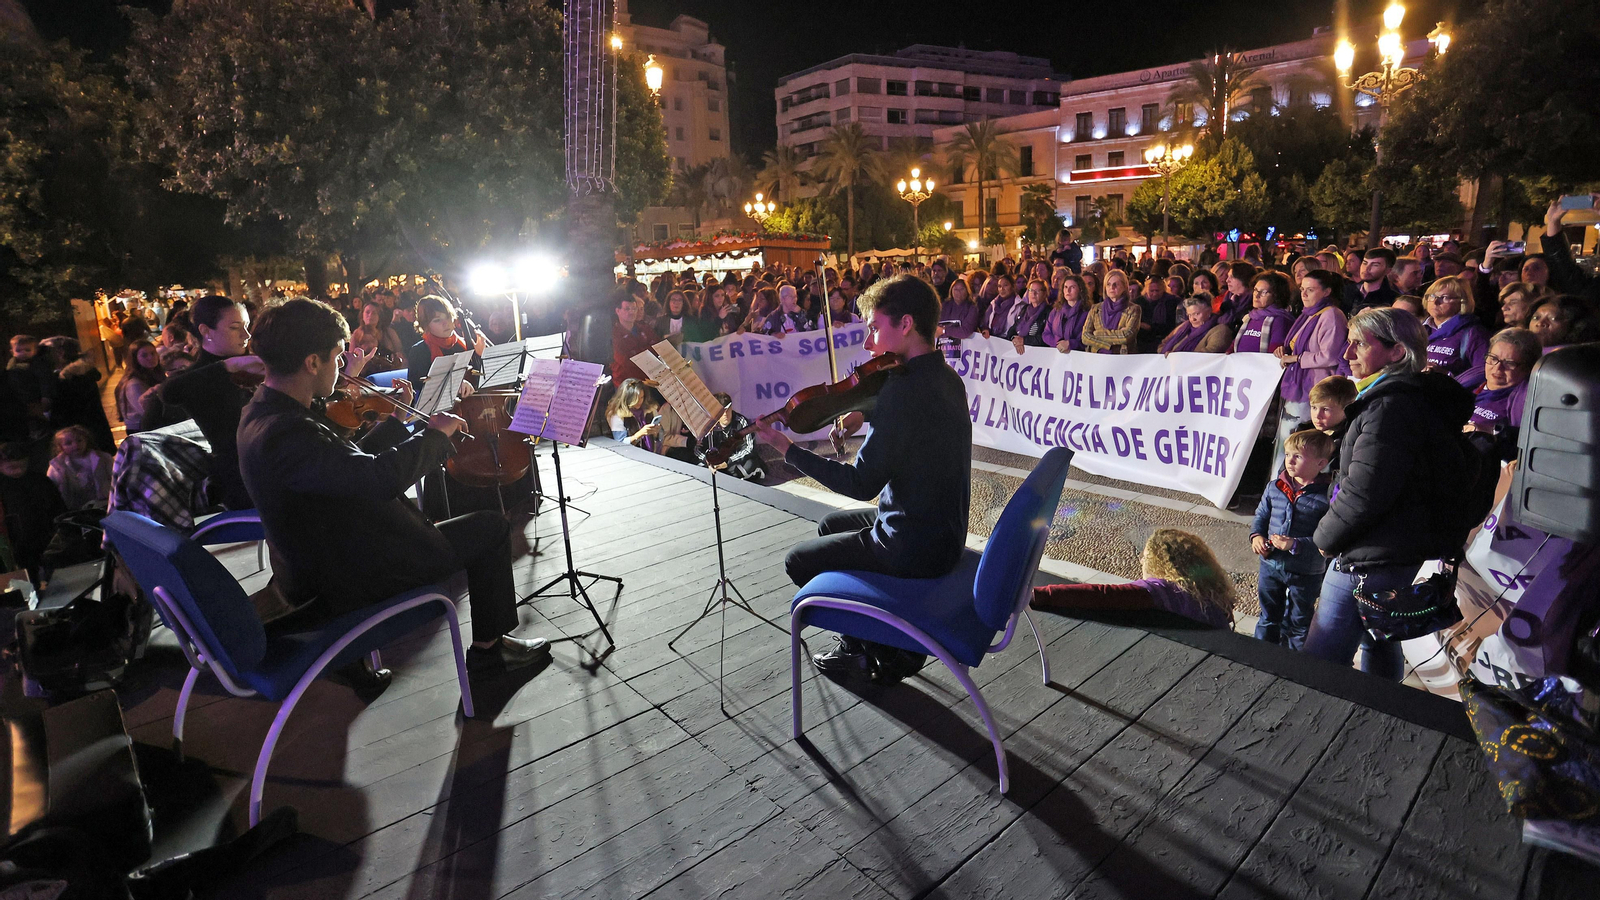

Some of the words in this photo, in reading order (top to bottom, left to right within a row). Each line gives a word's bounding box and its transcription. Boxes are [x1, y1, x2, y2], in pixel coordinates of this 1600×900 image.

[1240, 50, 1276, 64] Arenal
[799, 329, 865, 355] SORD
[756, 381, 790, 400] NO
[1061, 370, 1083, 407] DE
[1088, 375, 1133, 411] LAS
[1133, 375, 1252, 420] MUJERES
[984, 397, 1009, 431] LA
[1111, 426, 1148, 461] DE
[1154, 425, 1241, 478] GÉNER
